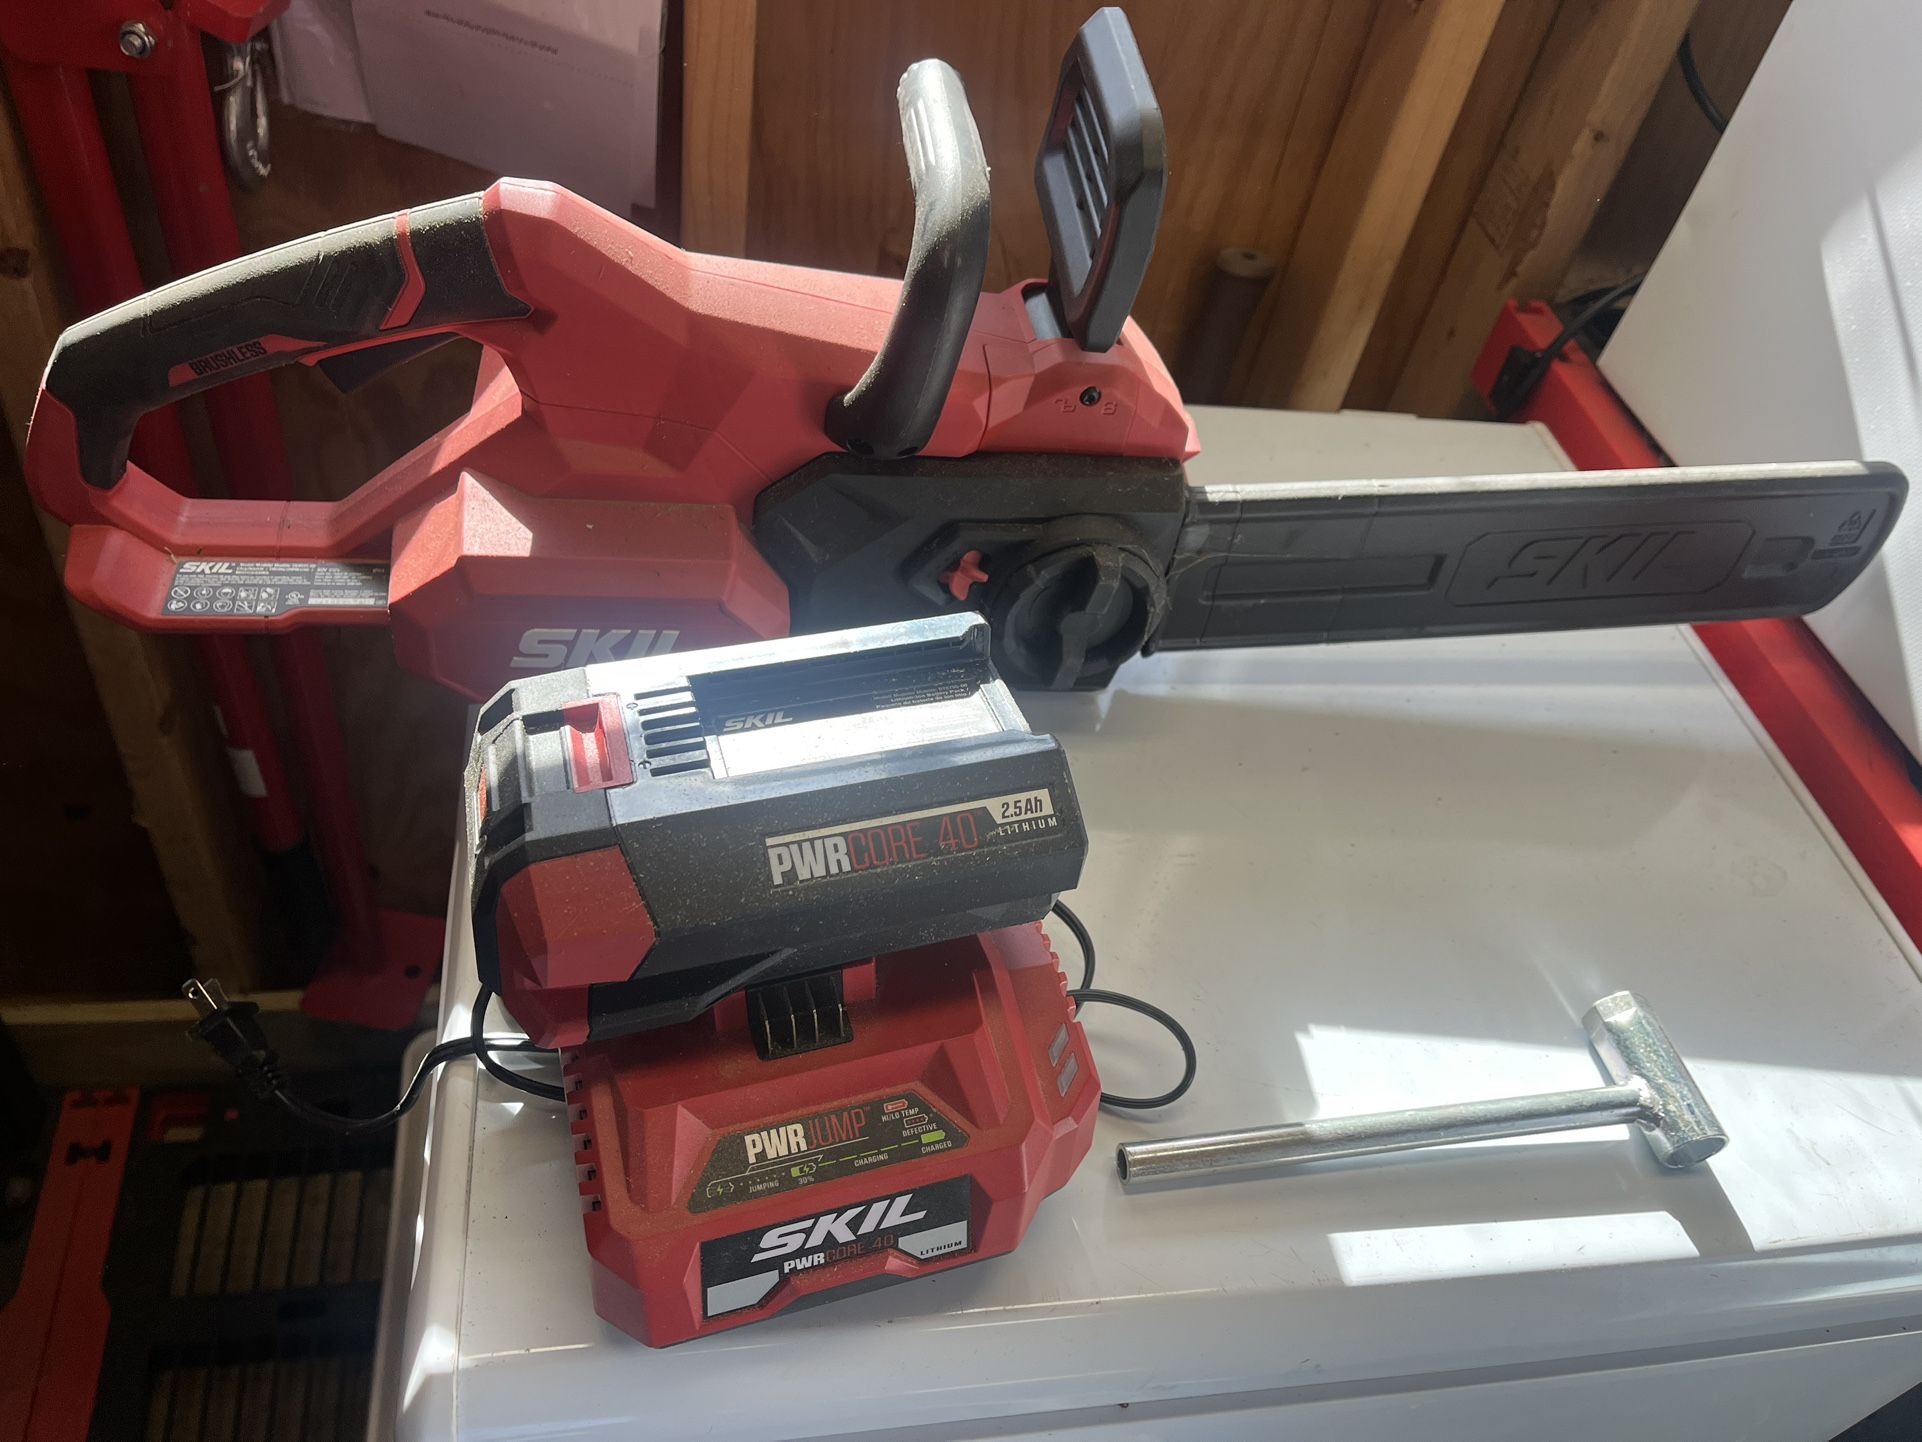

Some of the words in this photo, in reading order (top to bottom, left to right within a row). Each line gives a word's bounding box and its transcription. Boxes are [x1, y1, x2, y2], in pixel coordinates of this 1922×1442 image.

[188, 340, 268, 376] BRUSHLESS
[179, 561, 233, 574] SKIL
[1487, 531, 1692, 592] SKIL
[723, 711, 793, 732] SKIL
[1001, 796, 1043, 819] 2.5Ah
[997, 816, 1058, 837] LITHIUM
[767, 820, 929, 886] PWRCORE
[901, 1107, 919, 1118] TEMP
[902, 1122, 938, 1138] DEFECTIVE
[921, 1140, 952, 1154] CHARGED
[854, 1152, 889, 1167] CHARGING
[748, 1179, 780, 1194] JUMPING
[798, 1175, 815, 1186] 30%
[751, 1194, 927, 1263] SKIL
[783, 1243, 865, 1274] PWRCORE
[872, 1234, 895, 1252] 40
[920, 1240, 963, 1256] LITHIUM
